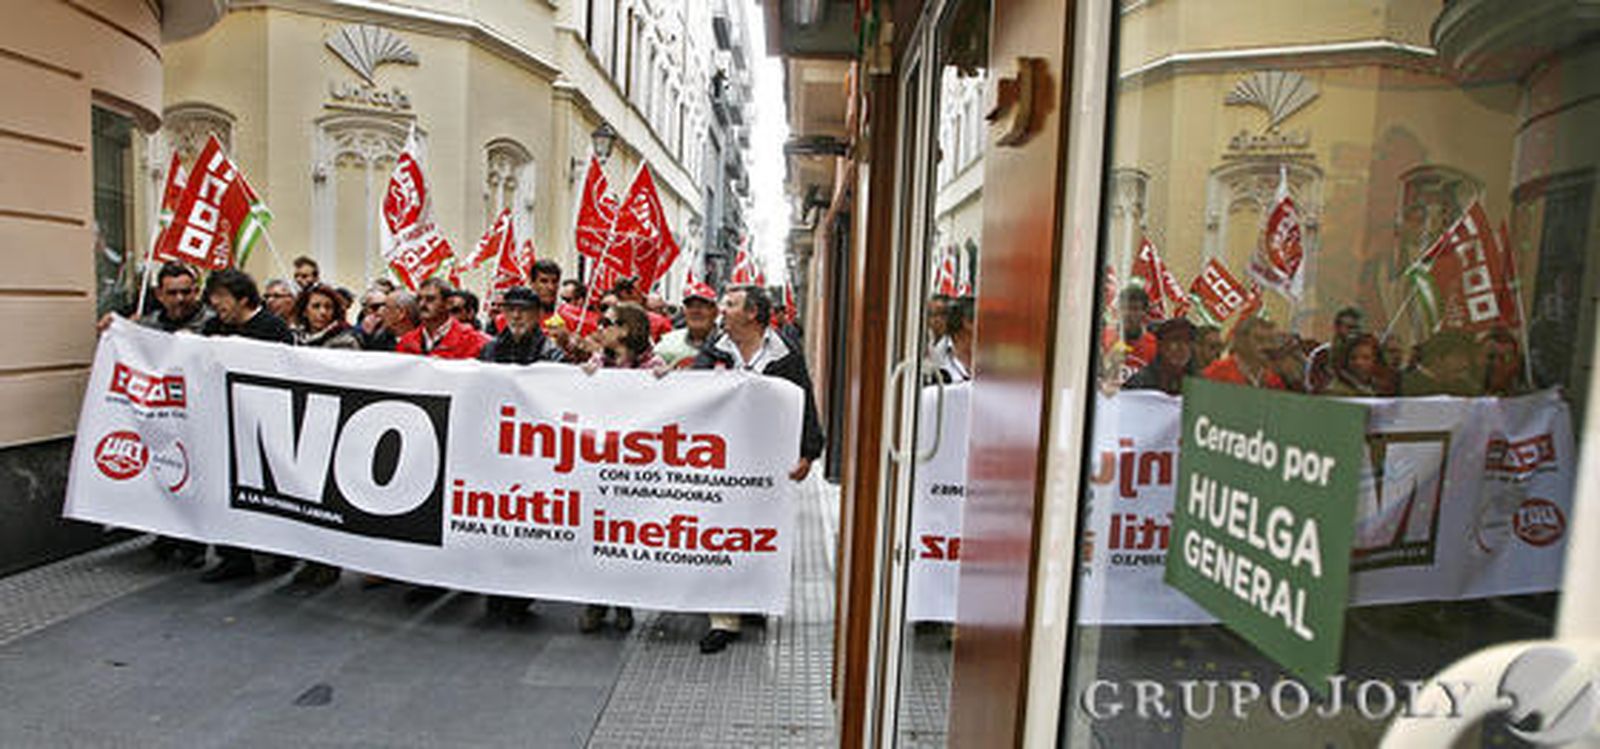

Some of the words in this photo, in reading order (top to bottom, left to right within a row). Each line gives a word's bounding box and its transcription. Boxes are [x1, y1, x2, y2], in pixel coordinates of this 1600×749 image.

[231, 382, 440, 517] NO
[498, 405, 727, 474] injusta
[1194, 415, 1279, 469] Cerrado
[1283, 446, 1335, 486] por
[598, 468, 630, 482] CON
[634, 470, 662, 483] LOS
[666, 470, 774, 489] TRABAJADORES
[598, 484, 609, 496] Y
[613, 485, 723, 503] TRABAJADORAS
[452, 479, 581, 527] inútil
[1187, 472, 1322, 578] HUELGA
[451, 520, 488, 535] PARA
[492, 524, 511, 538] EL
[514, 526, 576, 542] EMPLEO
[592, 545, 629, 560] PARA
[632, 548, 651, 562] LA
[593, 509, 778, 553] ineficaz
[1184, 529, 1315, 641] GENERAL
